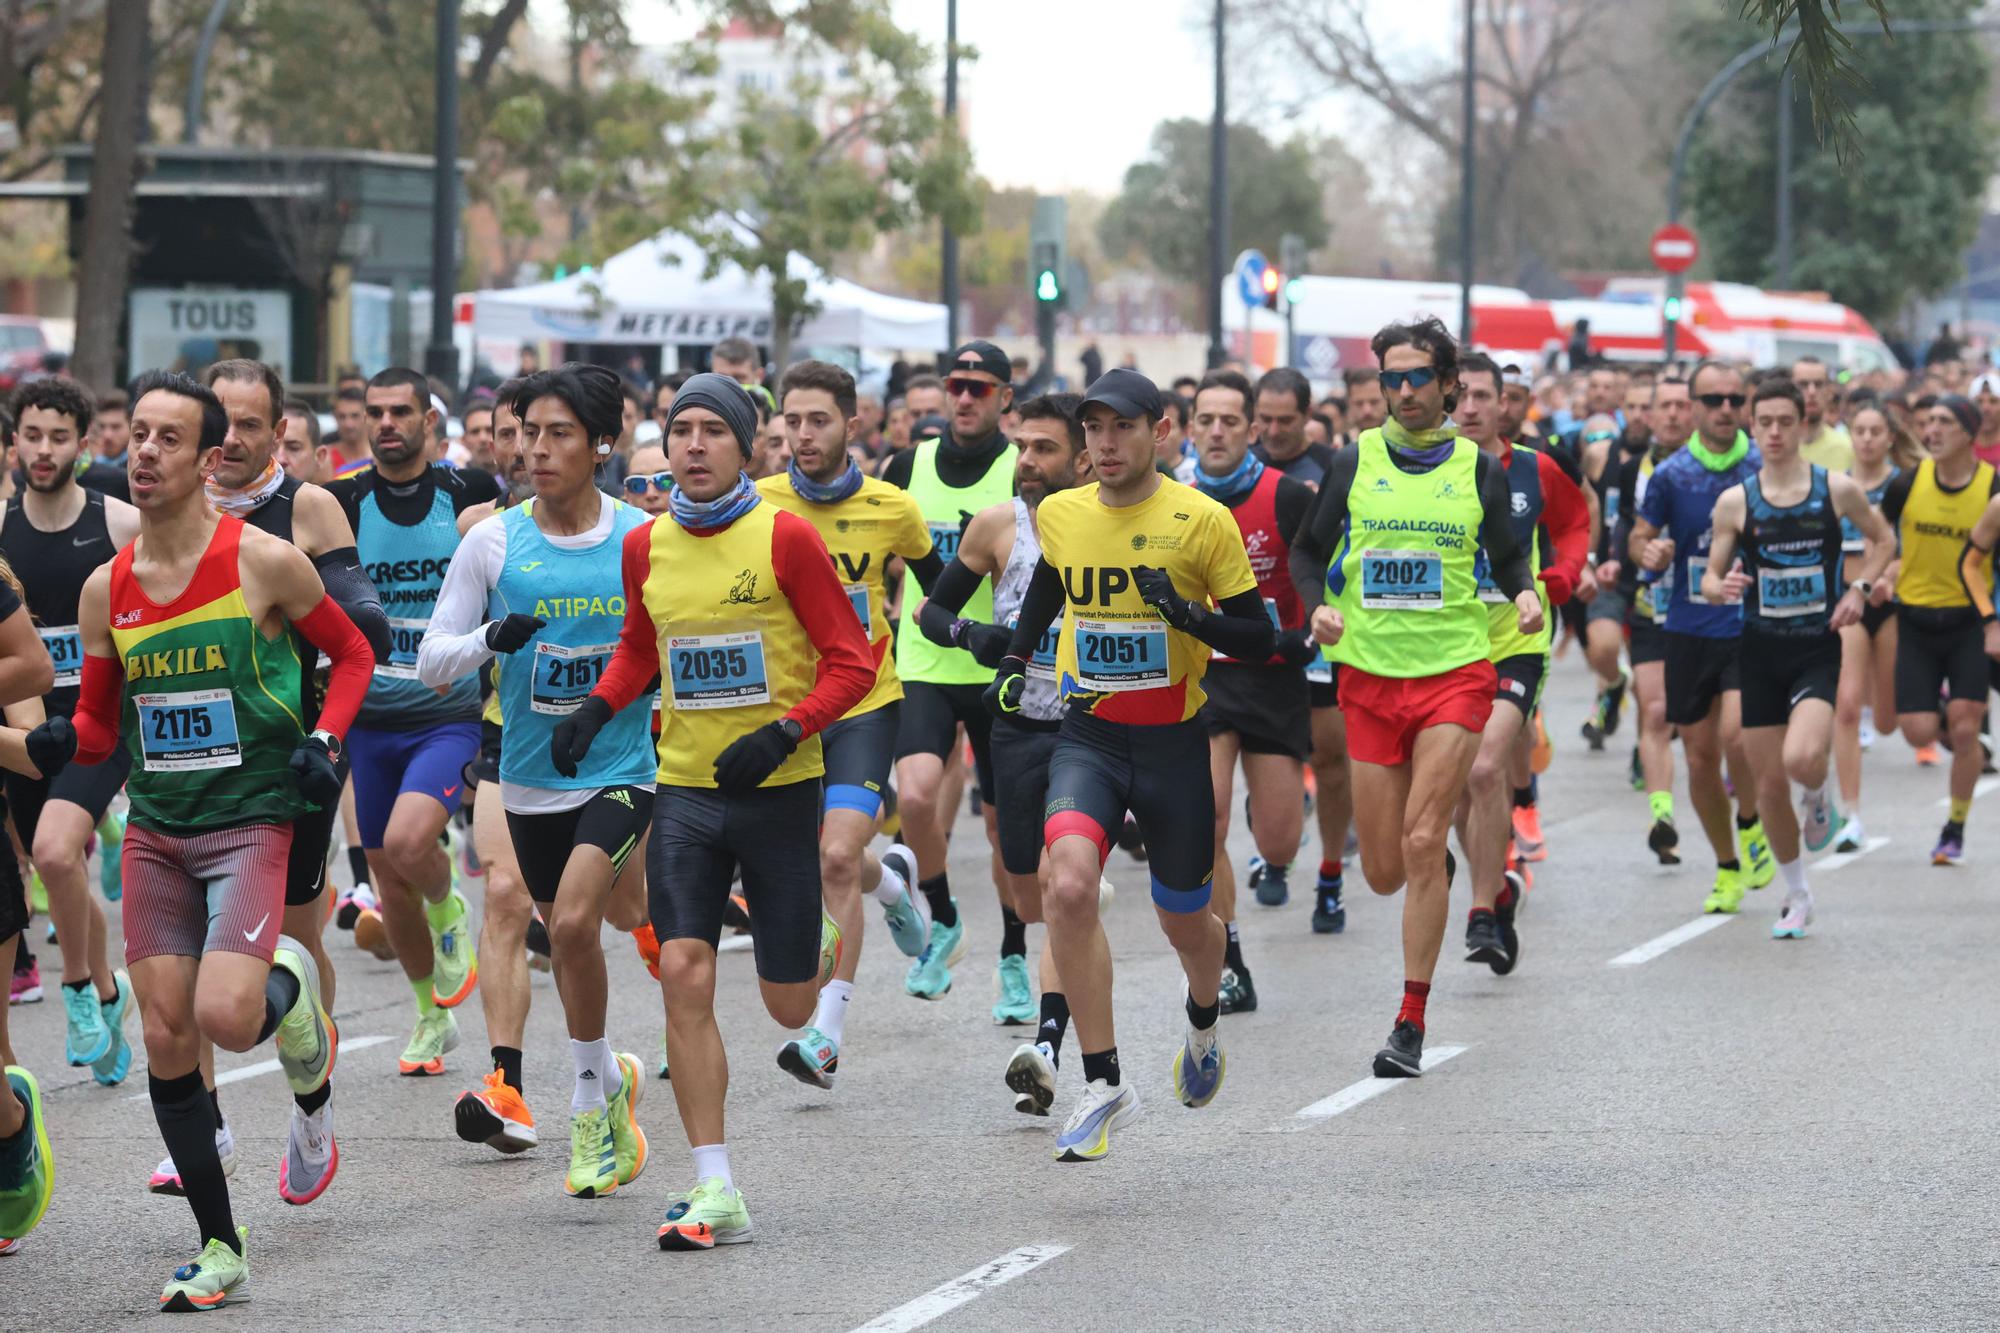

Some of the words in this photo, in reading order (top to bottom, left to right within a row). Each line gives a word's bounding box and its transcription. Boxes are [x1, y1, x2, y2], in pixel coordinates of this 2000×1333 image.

[168, 300, 256, 332] TOUS
[616, 314, 805, 338] METAESPOT
[1362, 519, 1466, 536] TRAGALEGUAS
[1372, 560, 1428, 585] 2002
[1767, 577, 1814, 599] 2334
[533, 596, 626, 619] ATIPAQ
[43, 636, 79, 662] 31
[1085, 634, 1149, 664] 2051
[126, 644, 228, 683] BIKILA
[547, 656, 603, 689] 2151
[678, 648, 748, 681] 2035
[152, 707, 213, 741] 2175
